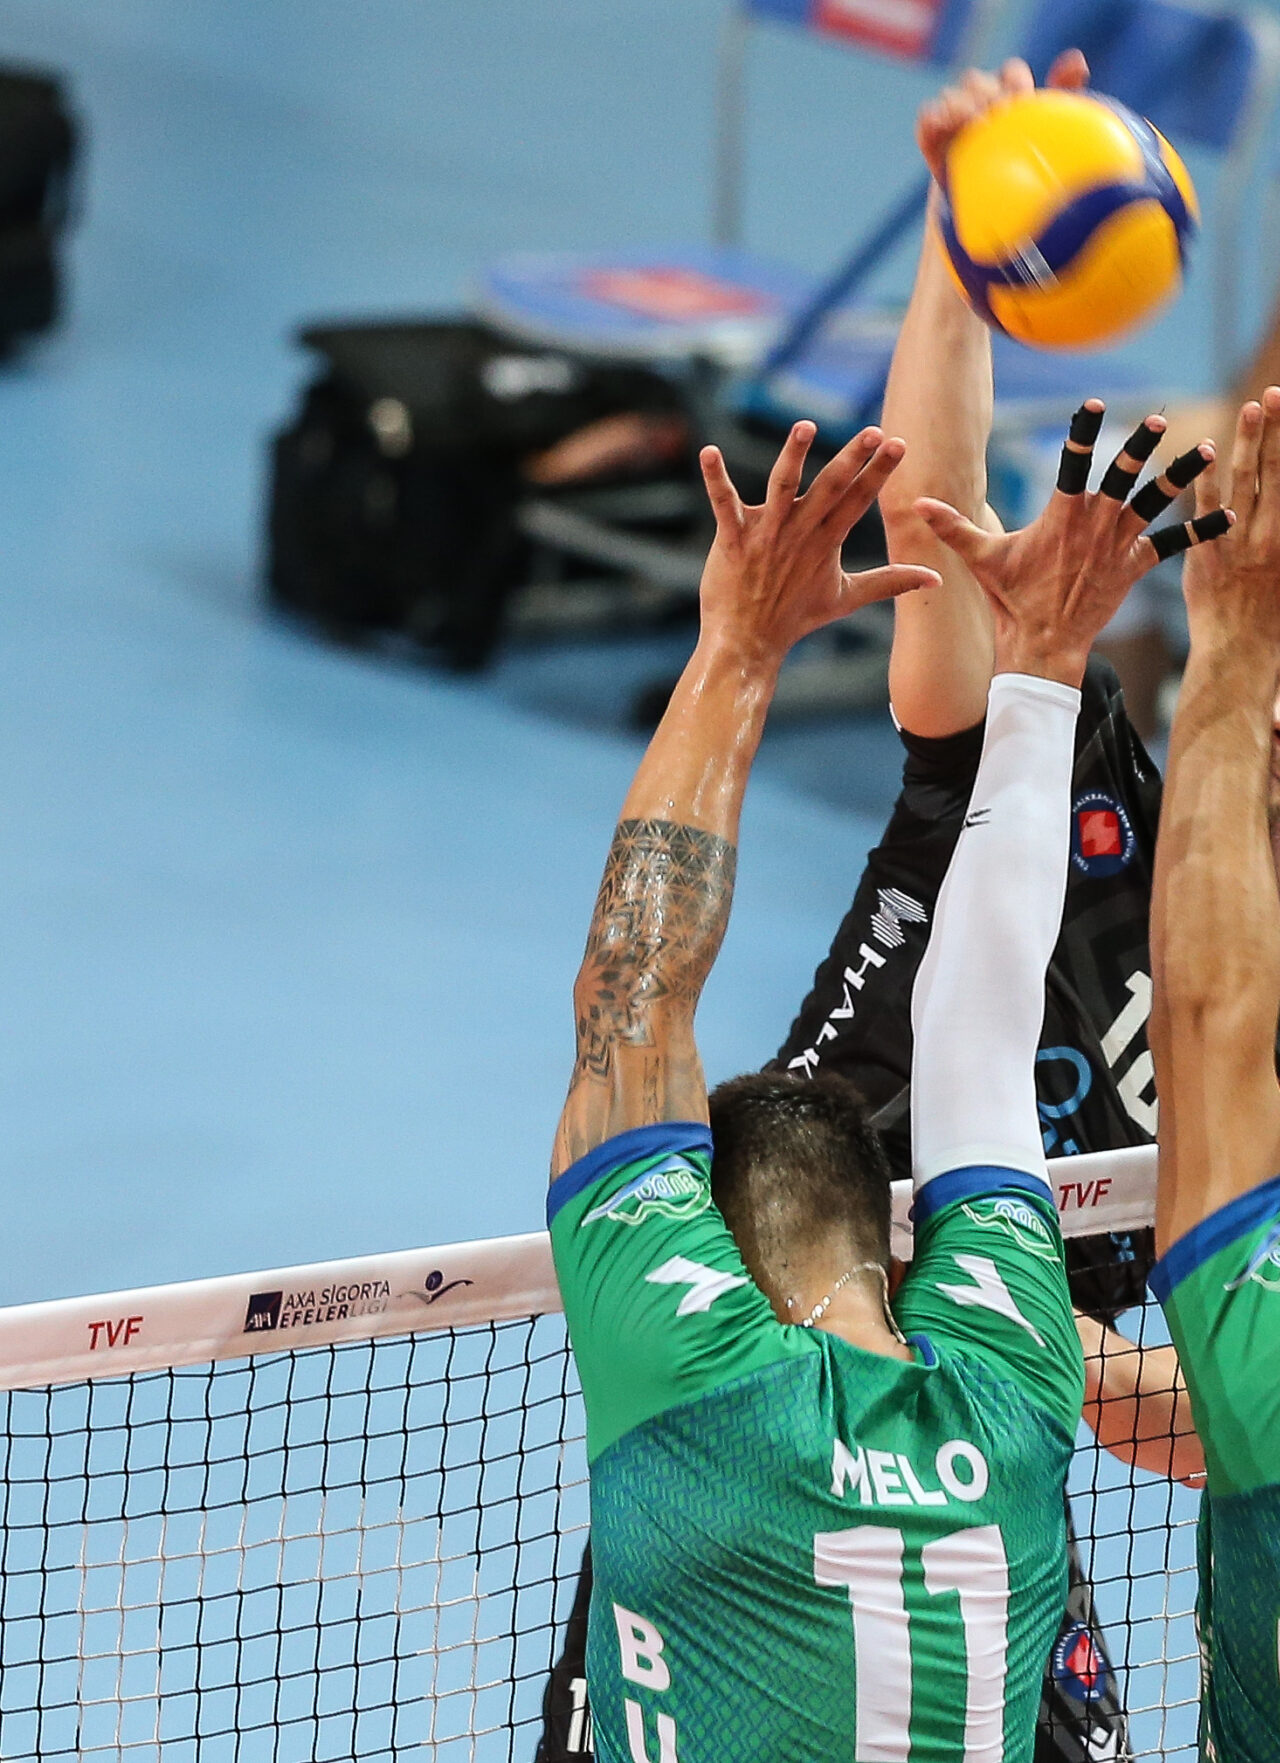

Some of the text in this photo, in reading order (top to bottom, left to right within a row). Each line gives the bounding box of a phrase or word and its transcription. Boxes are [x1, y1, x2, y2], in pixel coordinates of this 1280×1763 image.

[1058, 1178, 1112, 1212] TVF
[283, 1280, 390, 1310] AXA SİGORTA
[87, 1316, 144, 1350] TVF
[830, 1437, 990, 1507] MELO
[813, 1524, 1012, 1763] 11
